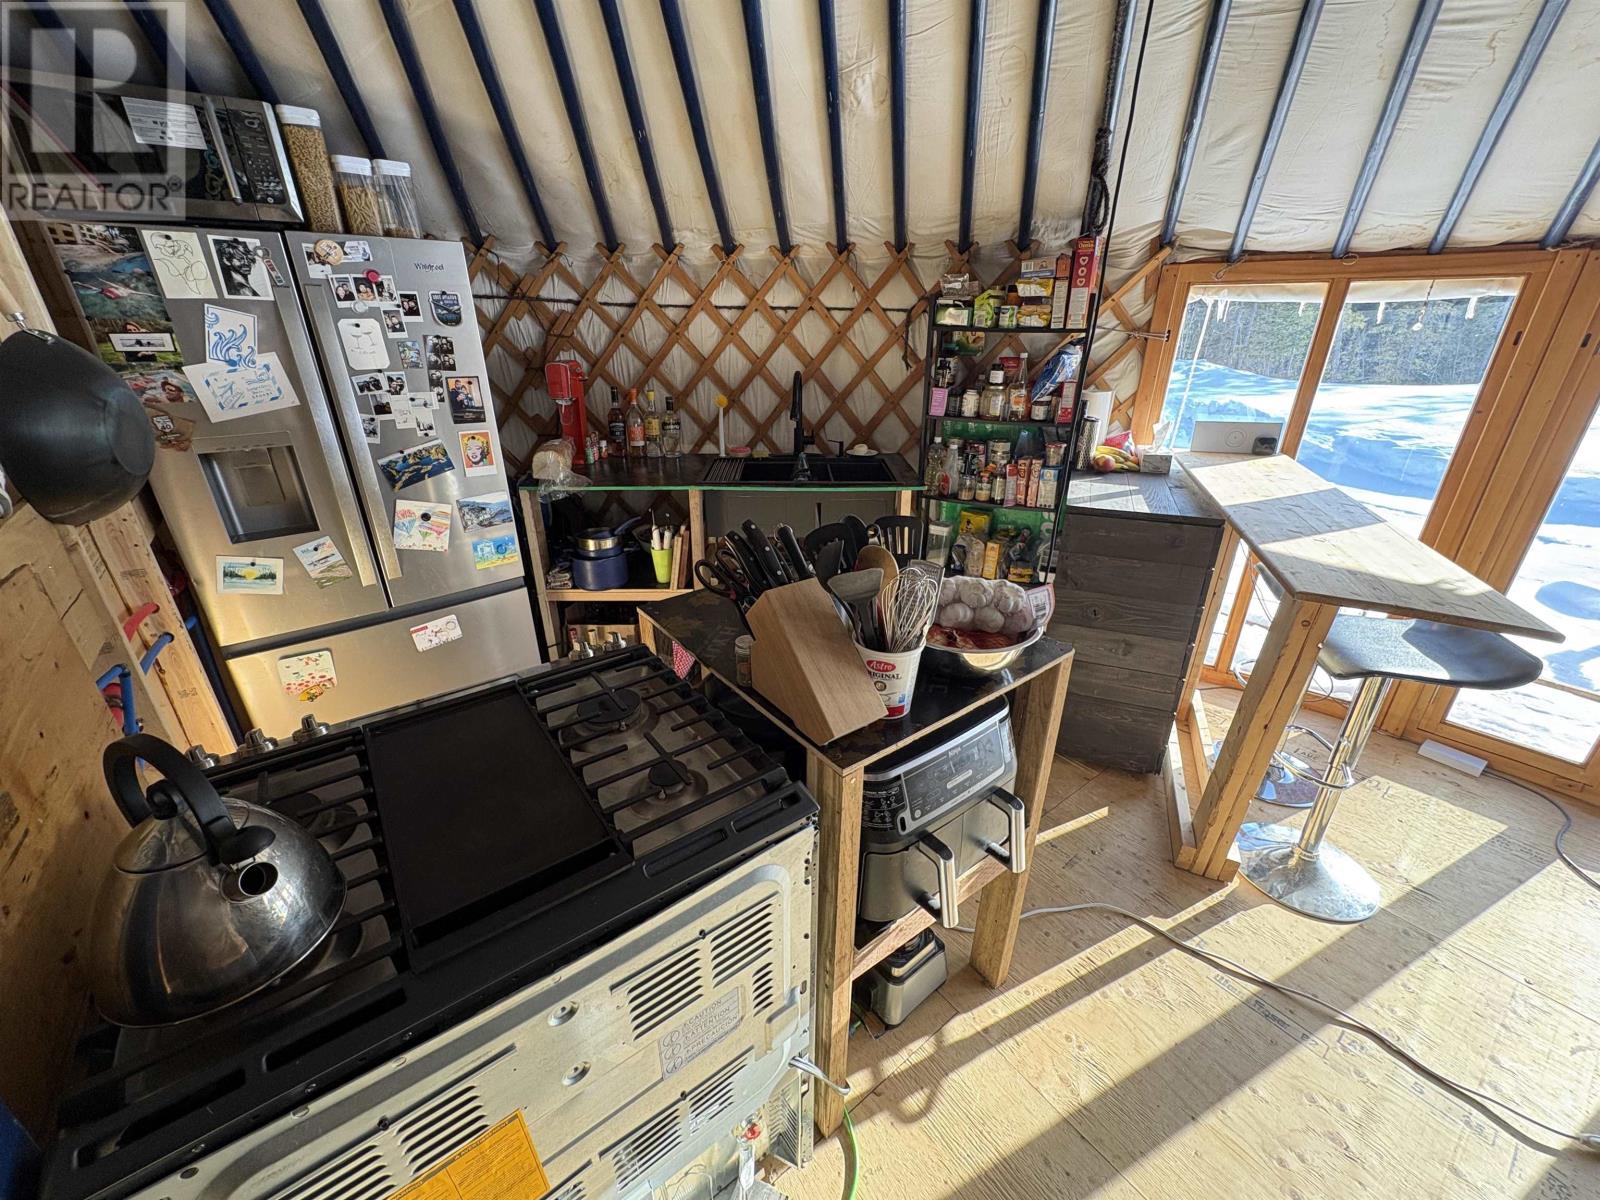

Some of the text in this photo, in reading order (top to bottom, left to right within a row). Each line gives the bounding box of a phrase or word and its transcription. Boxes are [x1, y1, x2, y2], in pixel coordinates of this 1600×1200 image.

[870, 661, 893, 671] Astro
[868, 671, 902, 680] RIGINAL
[688, 999, 722, 1025] CAUTION
[690, 1006, 730, 1037] ATTENTION
